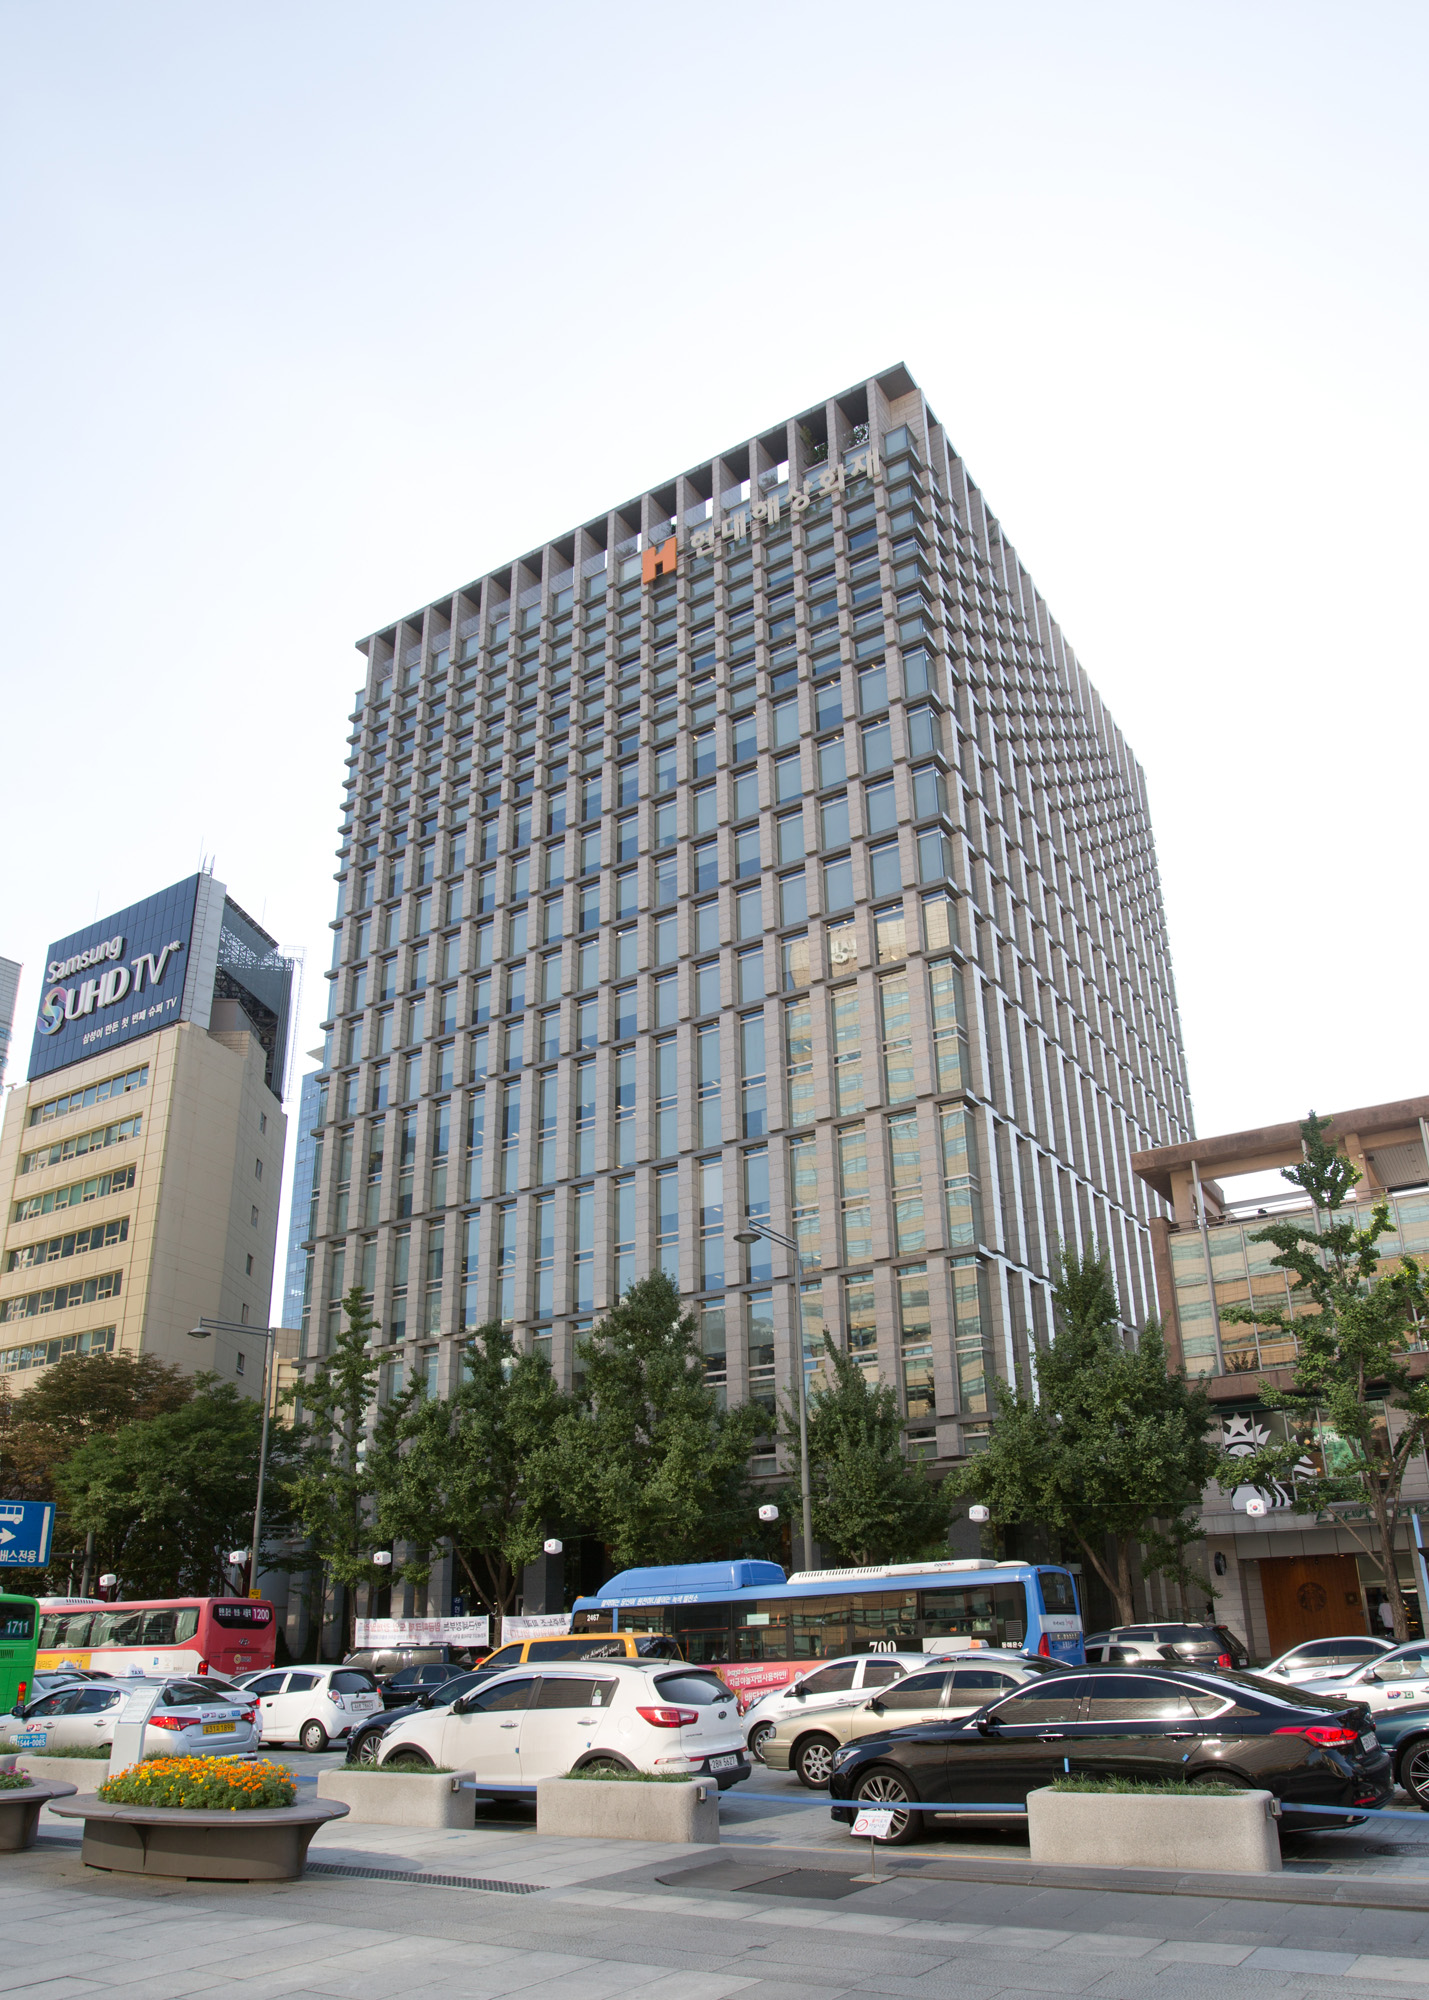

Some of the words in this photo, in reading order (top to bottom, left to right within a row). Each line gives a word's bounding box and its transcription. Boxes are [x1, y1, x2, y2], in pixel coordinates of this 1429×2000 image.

[690, 448, 880, 558] 현대해상화재
[46, 935, 123, 984] Samsung
[37, 966, 131, 1034] SUHD
[131, 943, 174, 992] TV
[82, 1027, 104, 1045] 삼성이
[105, 1020, 120, 1036] 만든
[121, 1016, 130, 1029] 첫
[132, 1009, 147, 1024] 번째
[148, 1002, 163, 1018] 슈퍼
[166, 996, 178, 1010] TV
[0, 1550, 36, 1562] 버스전용
[7, 1621, 29, 1634] 1711
[253, 1608, 270, 1620] 1200
[869, 1640, 897, 1653] 700
